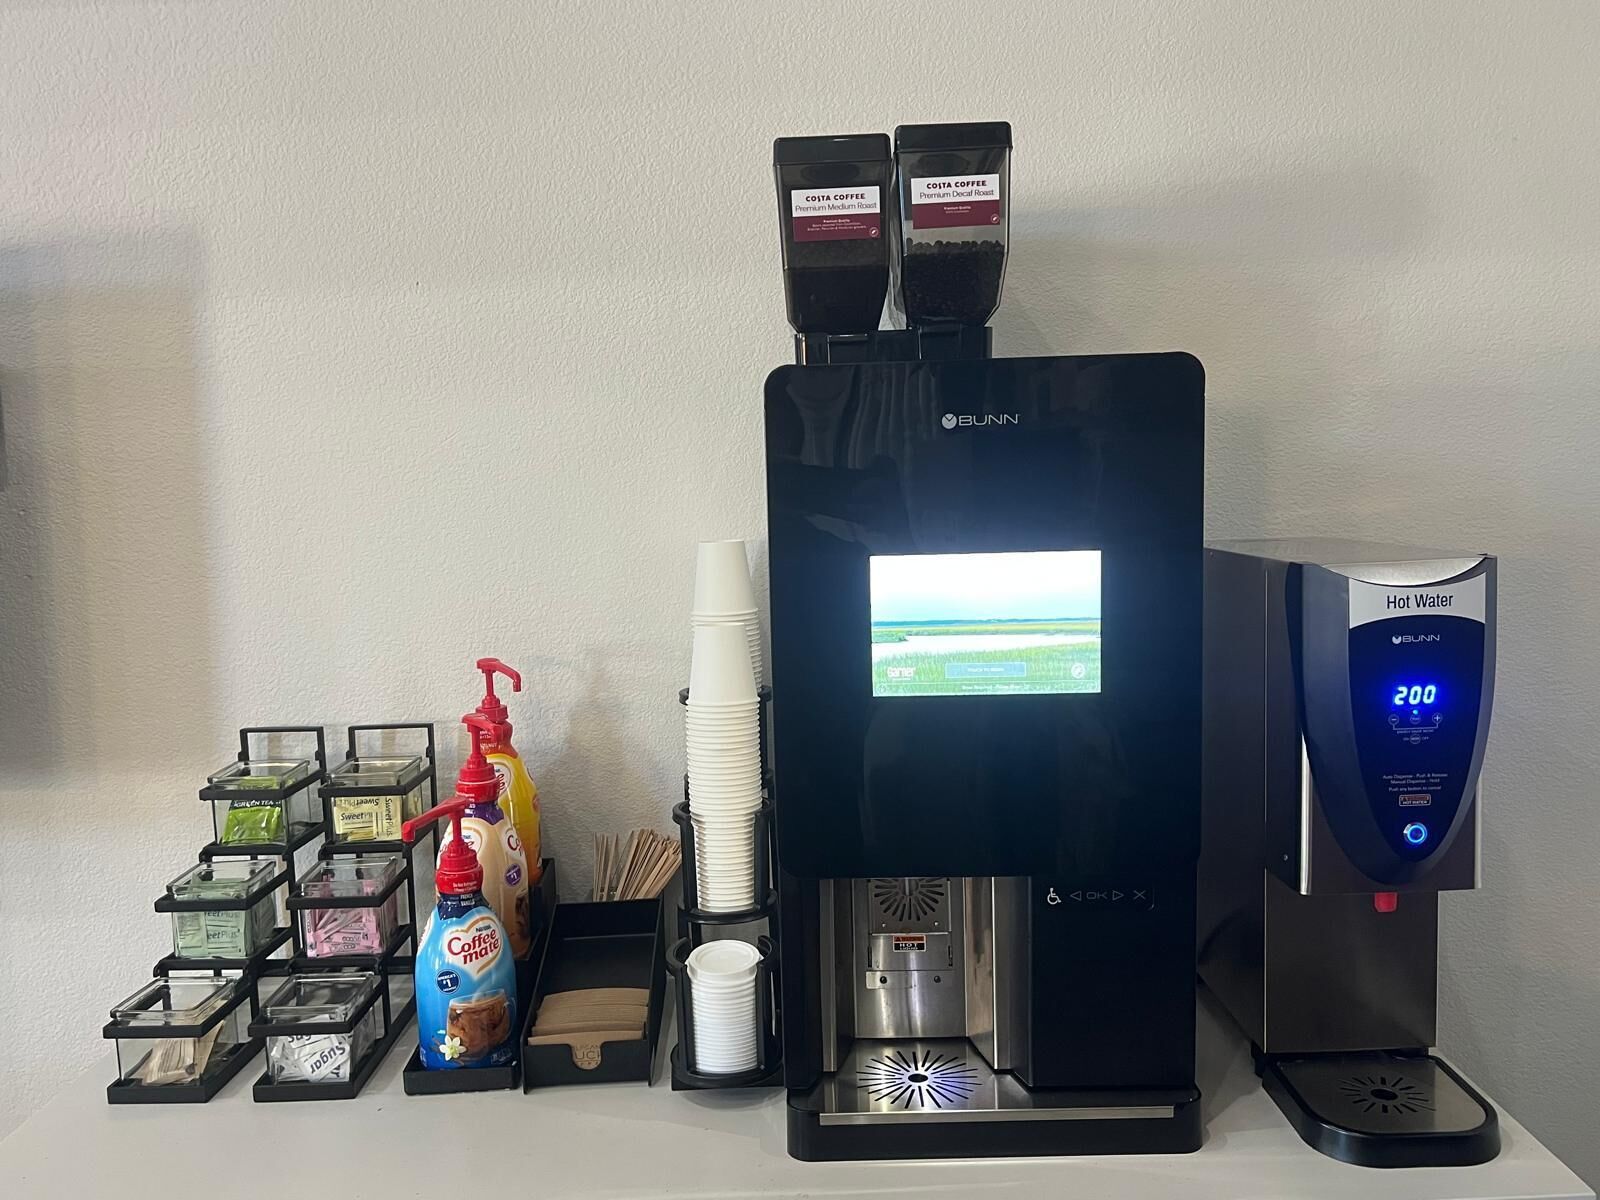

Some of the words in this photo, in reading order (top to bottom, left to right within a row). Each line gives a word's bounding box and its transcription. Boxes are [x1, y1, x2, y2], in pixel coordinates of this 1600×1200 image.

[926, 182, 952, 190] COSTA
[954, 180, 987, 188] COFFEE
[833, 193, 866, 201] COFFEE
[828, 203, 856, 211] Medium
[958, 413, 1019, 426] BUNN
[1386, 594, 1410, 609] Hot
[1414, 593, 1454, 608] Water
[1402, 634, 1440, 643] BUNN
[1393, 685, 1437, 705] 200
[1086, 891, 1108, 900] OK
[208, 931, 239, 939] eetPlus
[447, 929, 496, 956] Coffee
[463, 938, 499, 964] mate
[310, 1045, 346, 1074] Sugar
